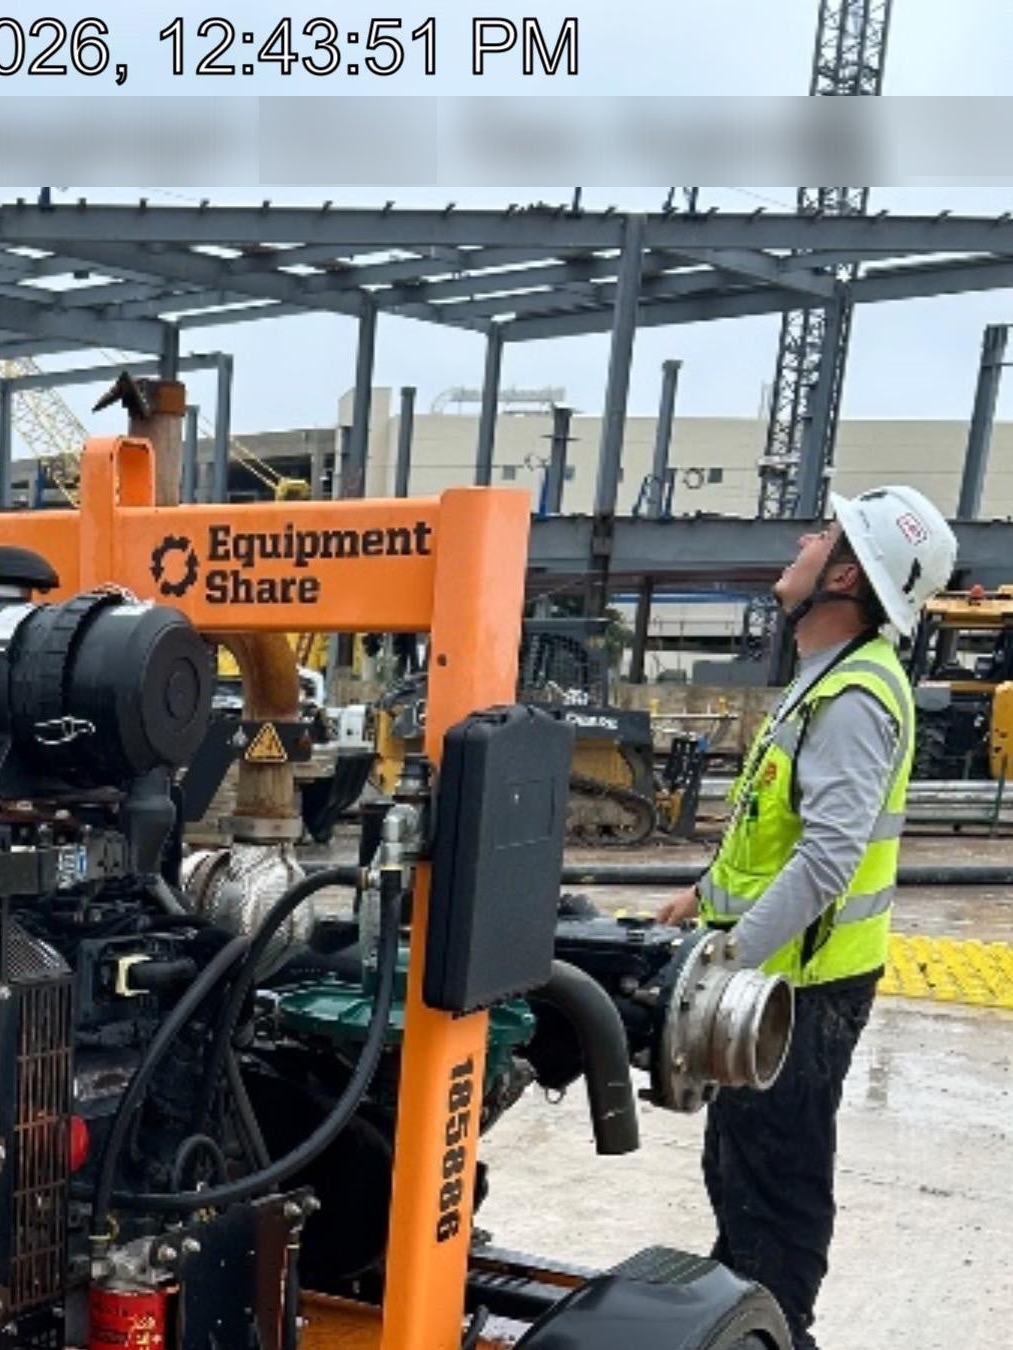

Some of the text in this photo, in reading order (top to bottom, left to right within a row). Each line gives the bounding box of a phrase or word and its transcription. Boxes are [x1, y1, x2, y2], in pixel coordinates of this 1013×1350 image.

[207, 522, 431, 567] Equipment
[204, 570, 320, 604] Share
[436, 1053, 473, 1243] 185886
